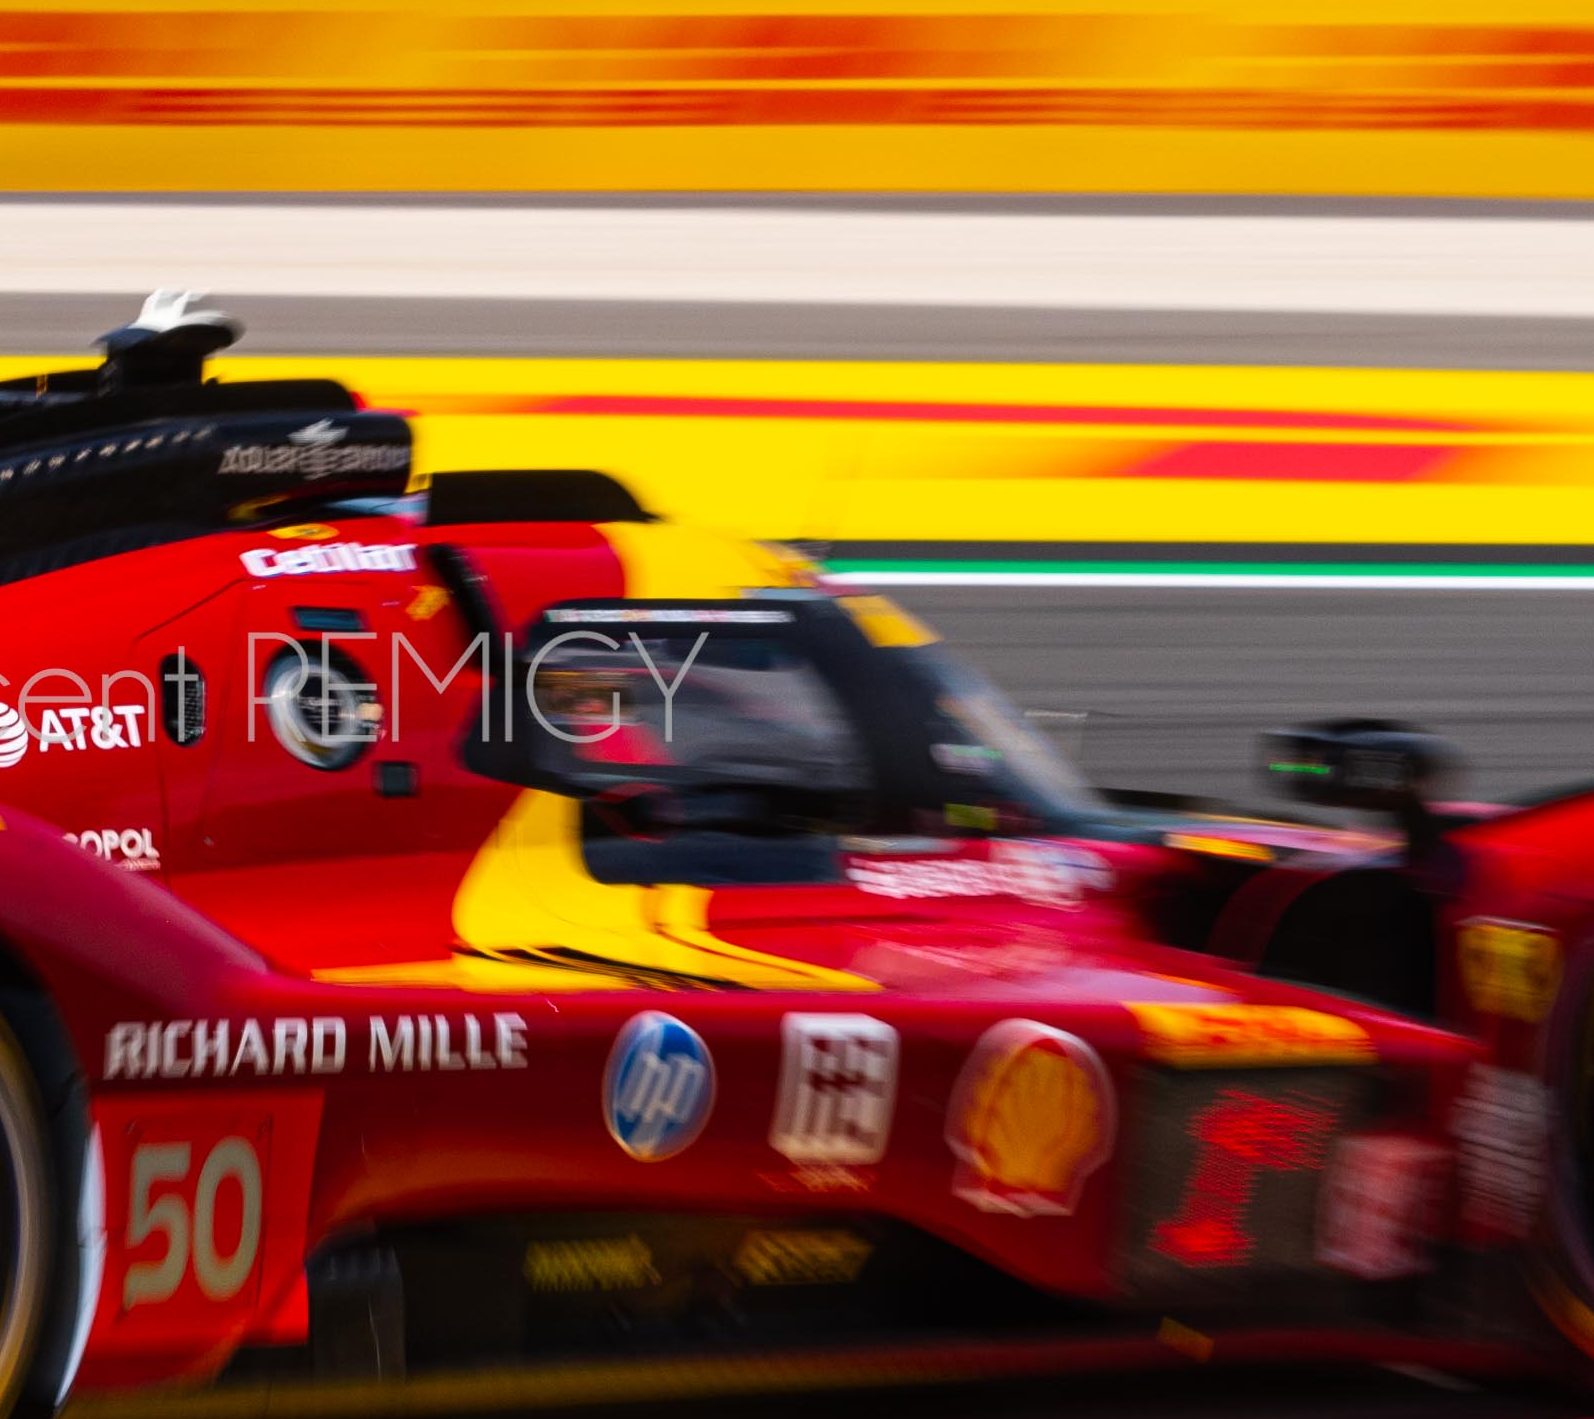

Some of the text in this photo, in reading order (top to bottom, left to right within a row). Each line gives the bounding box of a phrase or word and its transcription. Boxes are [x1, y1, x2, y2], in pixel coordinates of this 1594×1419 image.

[39, 705, 146, 753] AT&T
[103, 1012, 529, 1080] RICHARD MILLE
[123, 1135, 263, 1313] 50
